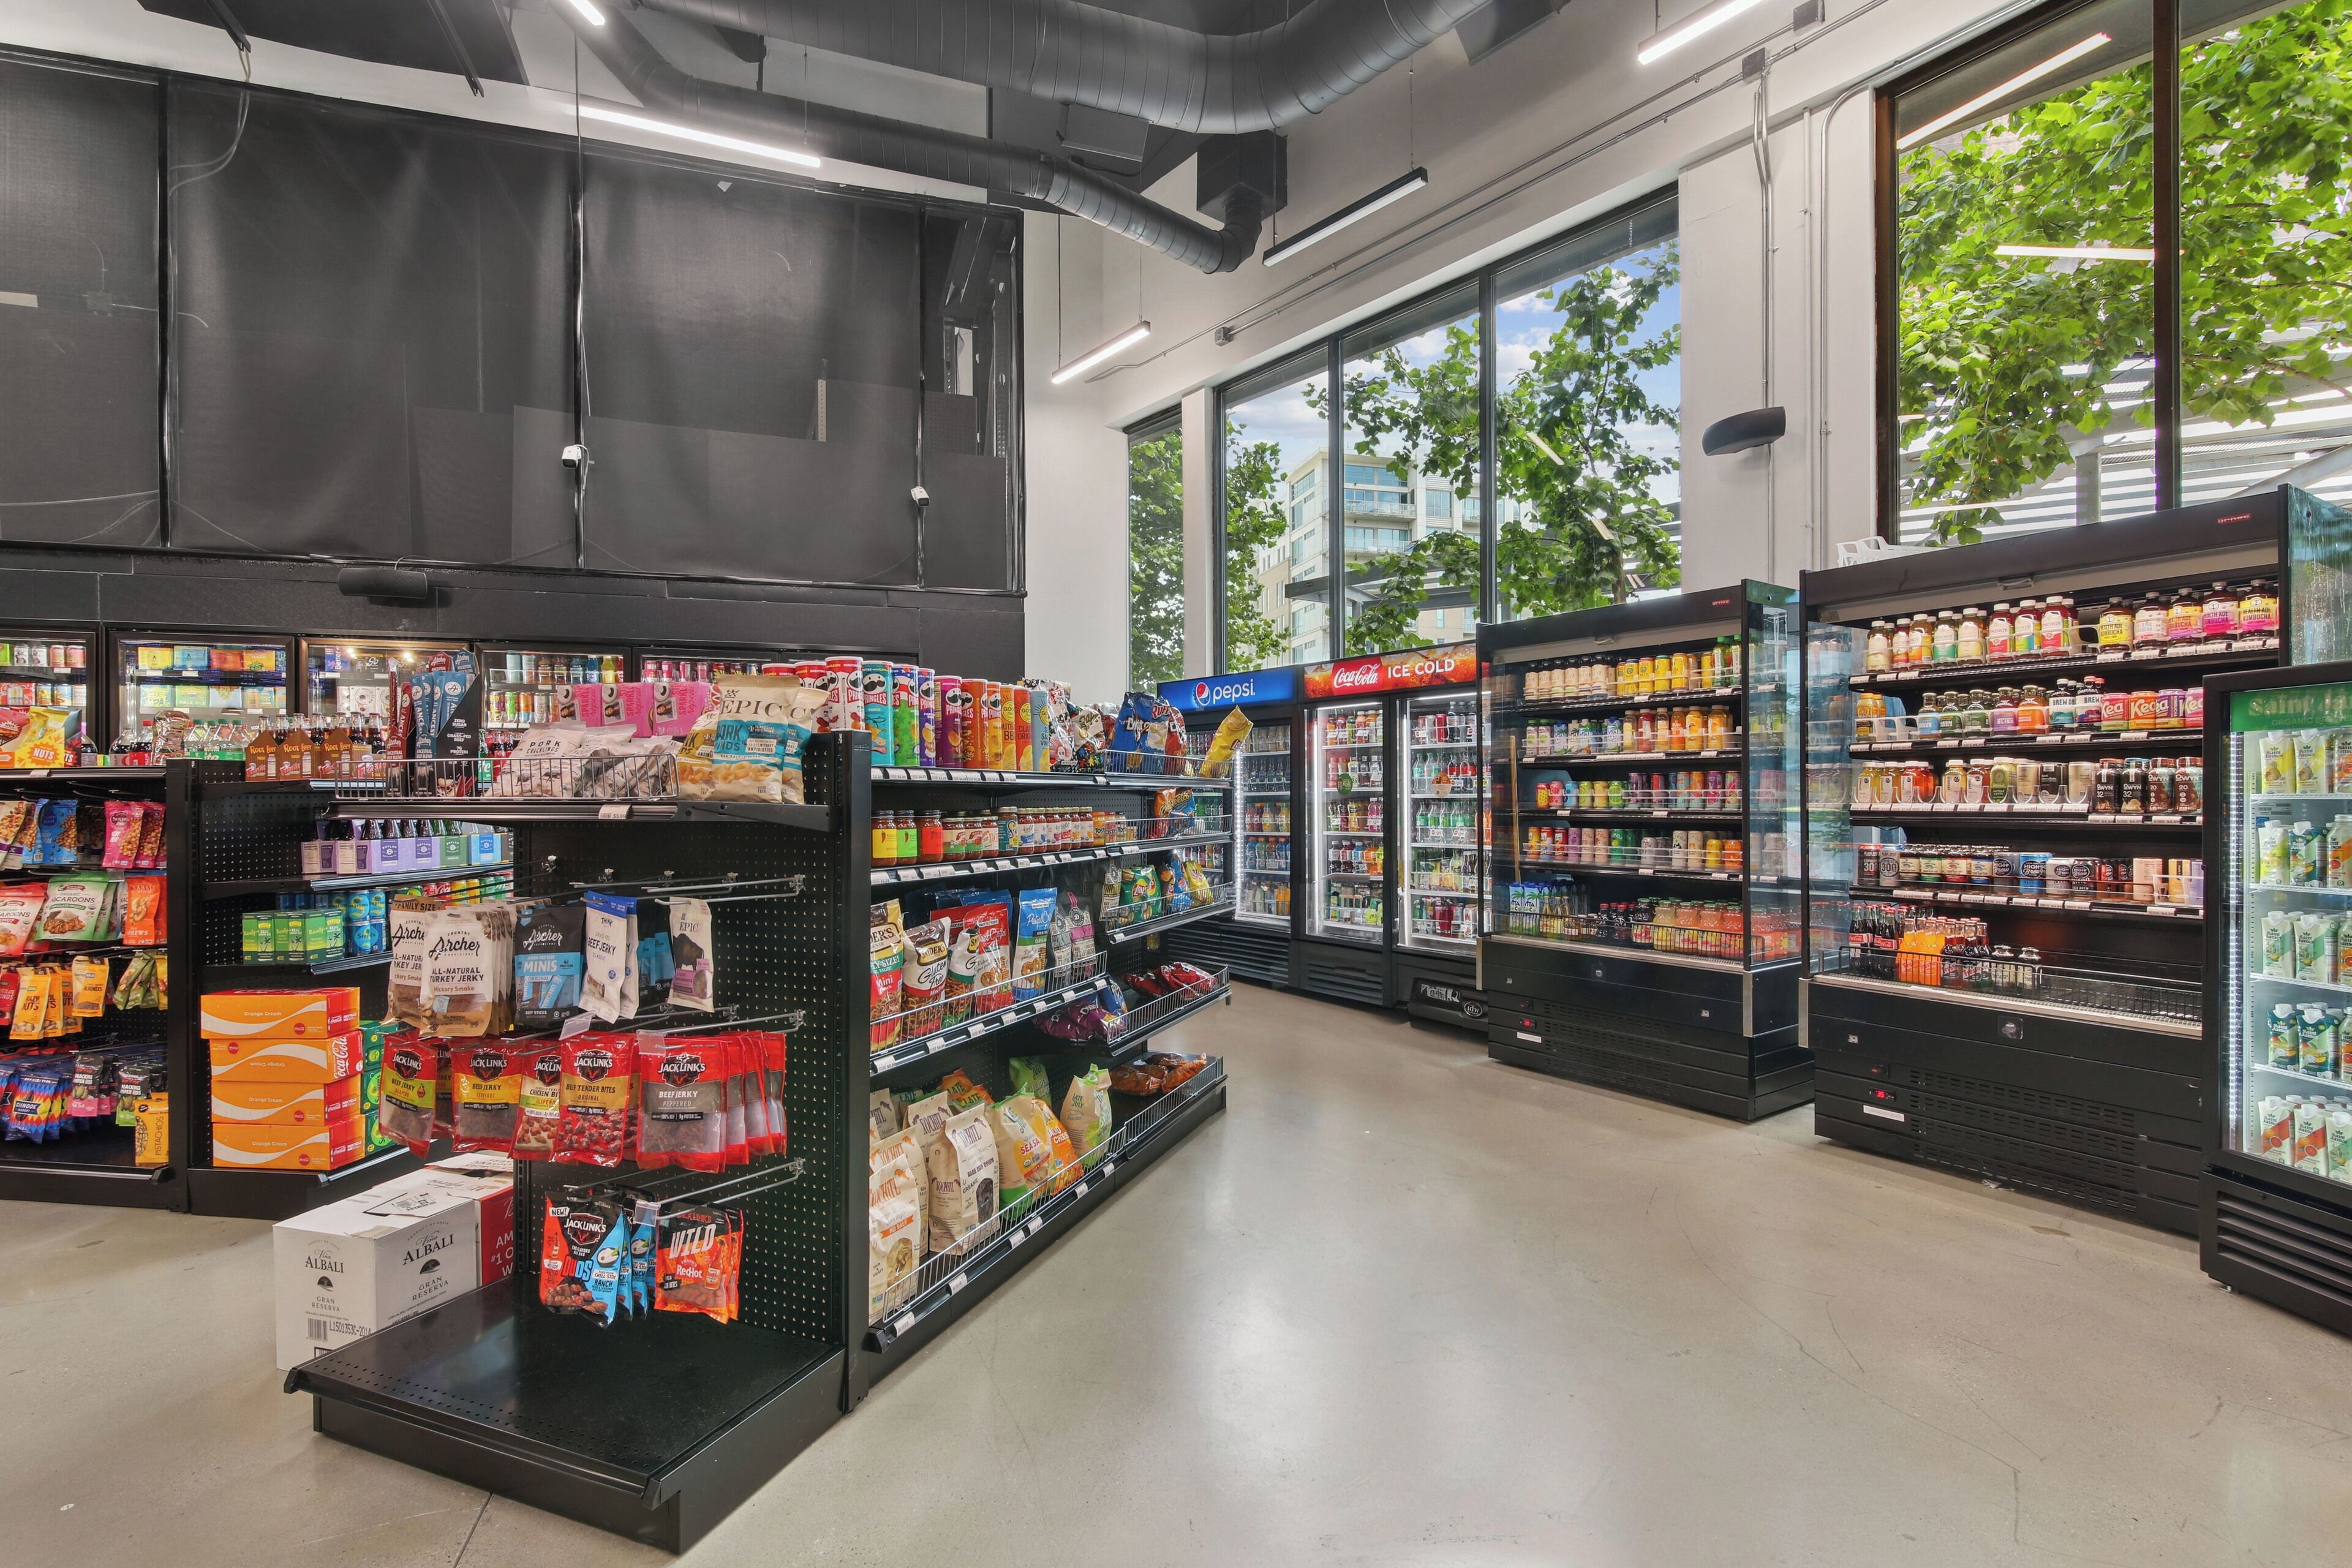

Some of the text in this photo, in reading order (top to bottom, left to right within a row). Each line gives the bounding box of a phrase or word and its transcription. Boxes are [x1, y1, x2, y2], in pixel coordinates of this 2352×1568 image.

[1333, 658, 1455, 688] Coca-Cola ICE COLD
[1212, 679, 1256, 703] pepsi
[720, 699, 783, 717] EPIC
[2271, 717, 2313, 726] ORGANIC
[33, 748, 55, 760] NUTS
[526, 745, 559, 754] CRACKLINGS
[1863, 862, 1878, 872] 300
[1880, 862, 1897, 872] 300
[420, 902, 436, 911] SIZE
[601, 917, 613, 927] THINK
[679, 921, 698, 933] EPIC
[522, 929, 563, 951] Archer
[428, 936, 480, 962] Archer
[587, 937, 616, 956] BEEF JERKY
[431, 967, 481, 975] ALL-NATURAL
[524, 960, 557, 973] MINIS
[918, 960, 948, 985] Gluten
[458, 974, 484, 982] JERKY
[929, 972, 944, 990] Free
[391, 1054, 407, 1066] JACK
[469, 1058, 485, 1068] JACK
[533, 1061, 549, 1071] JACK
[574, 1057, 592, 1066] JACK
[658, 1062, 679, 1073] JACK
[391, 1078, 415, 1091] BEEF JERKY
[529, 1088, 549, 1097] CHICKEN
[675, 1090, 699, 1099] JERKY
[1072, 1093, 1084, 1102] LATE
[963, 1093, 981, 1105] LATE
[1071, 1100, 1085, 1109] JULY
[155, 1115, 164, 1156] PISTACHIOS
[1020, 1143, 1033, 1155] SEA
[983, 1157, 995, 1168] CHIPS
[962, 1177, 979, 1194] ORGANIC
[551, 1208, 567, 1216] NEW!
[564, 1218, 584, 1228] JACK
[889, 1221, 908, 1235] NO SALT
[669, 1224, 717, 1259] WILD
[402, 1234, 454, 1266] ALBALI
[305, 1255, 344, 1273] ALBALI
[491, 1253, 503, 1265] #1
[561, 1254, 594, 1282] DUOS
[676, 1264, 703, 1278] RedHot
[419, 1275, 442, 1291] GRAN
[412, 1280, 448, 1302] RESERVA
[316, 1295, 335, 1304] GRAN
[312, 1302, 341, 1313] RESERVA
